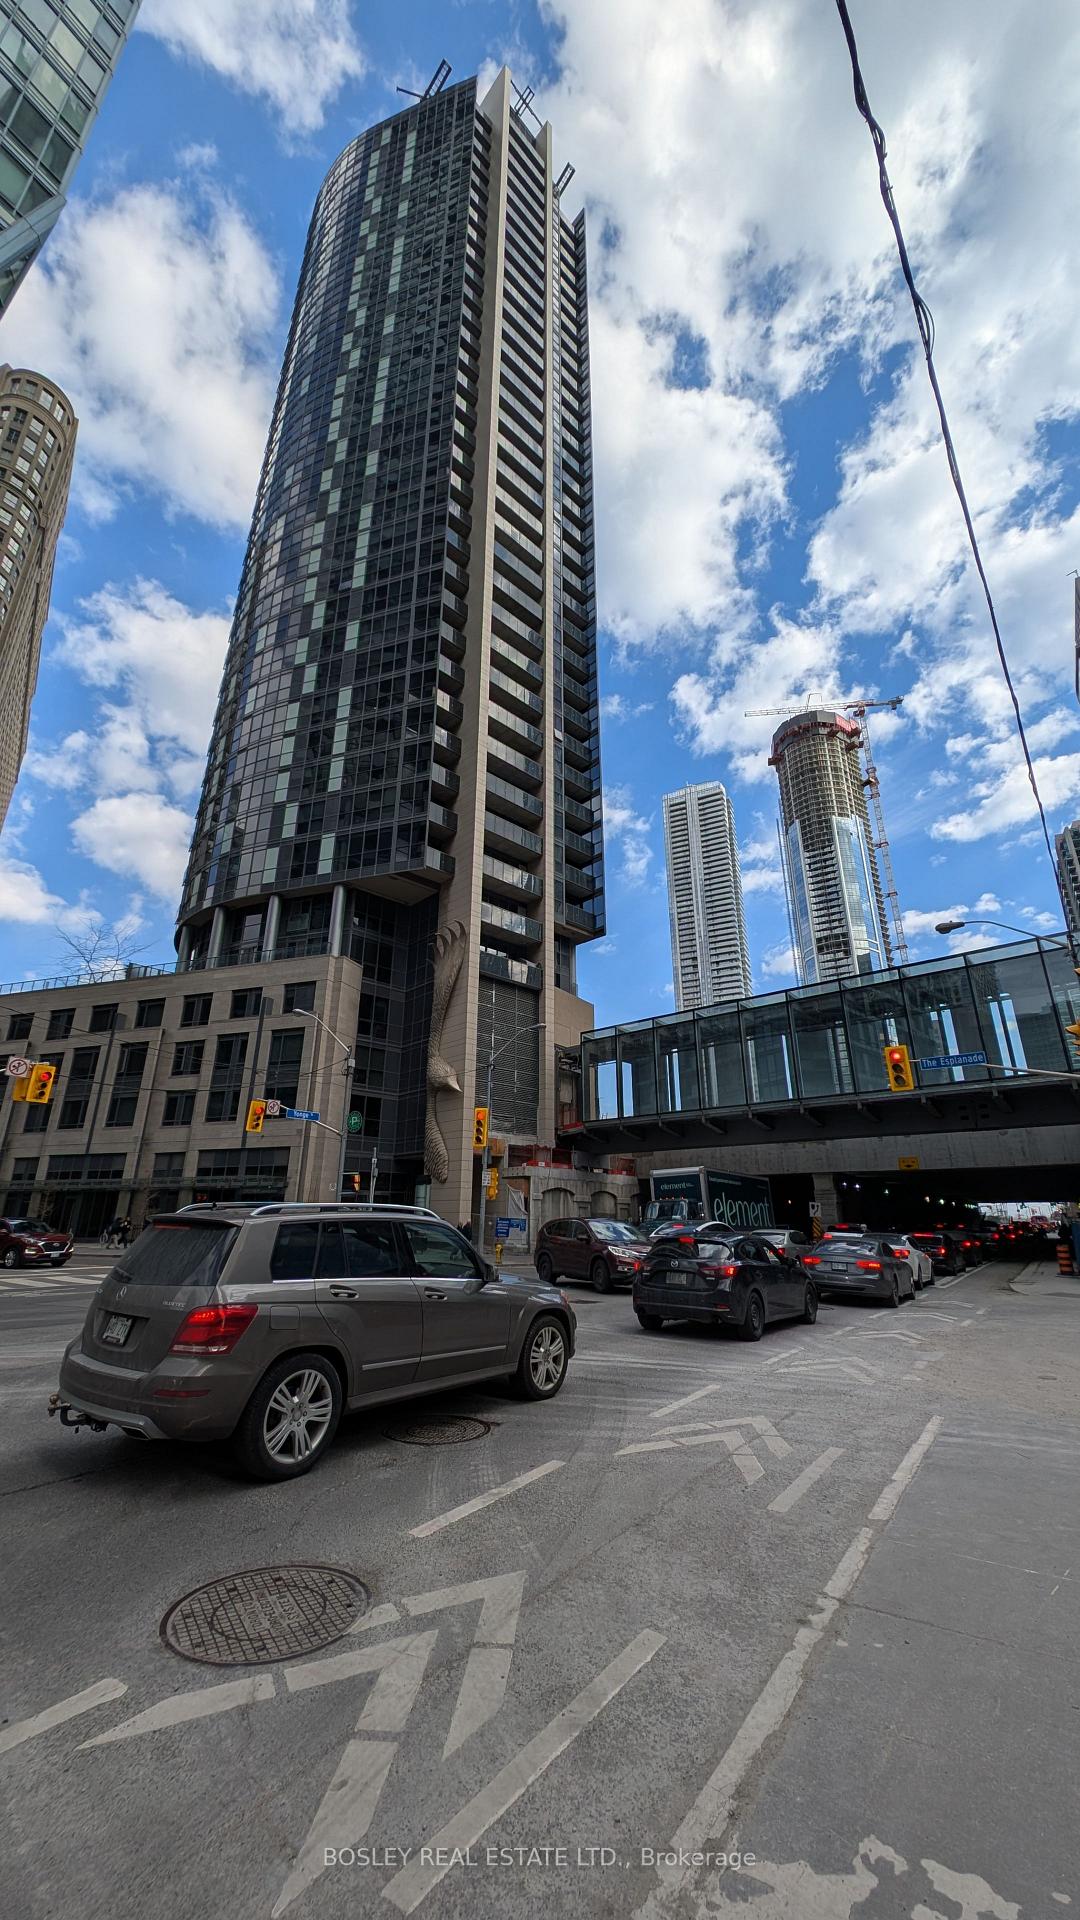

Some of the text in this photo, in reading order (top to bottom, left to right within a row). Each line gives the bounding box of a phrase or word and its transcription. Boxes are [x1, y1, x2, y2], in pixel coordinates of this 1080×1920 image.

[922, 1054, 984, 1068] The Esplanade
[660, 1182, 687, 1190] element
[713, 1191, 771, 1227] element
